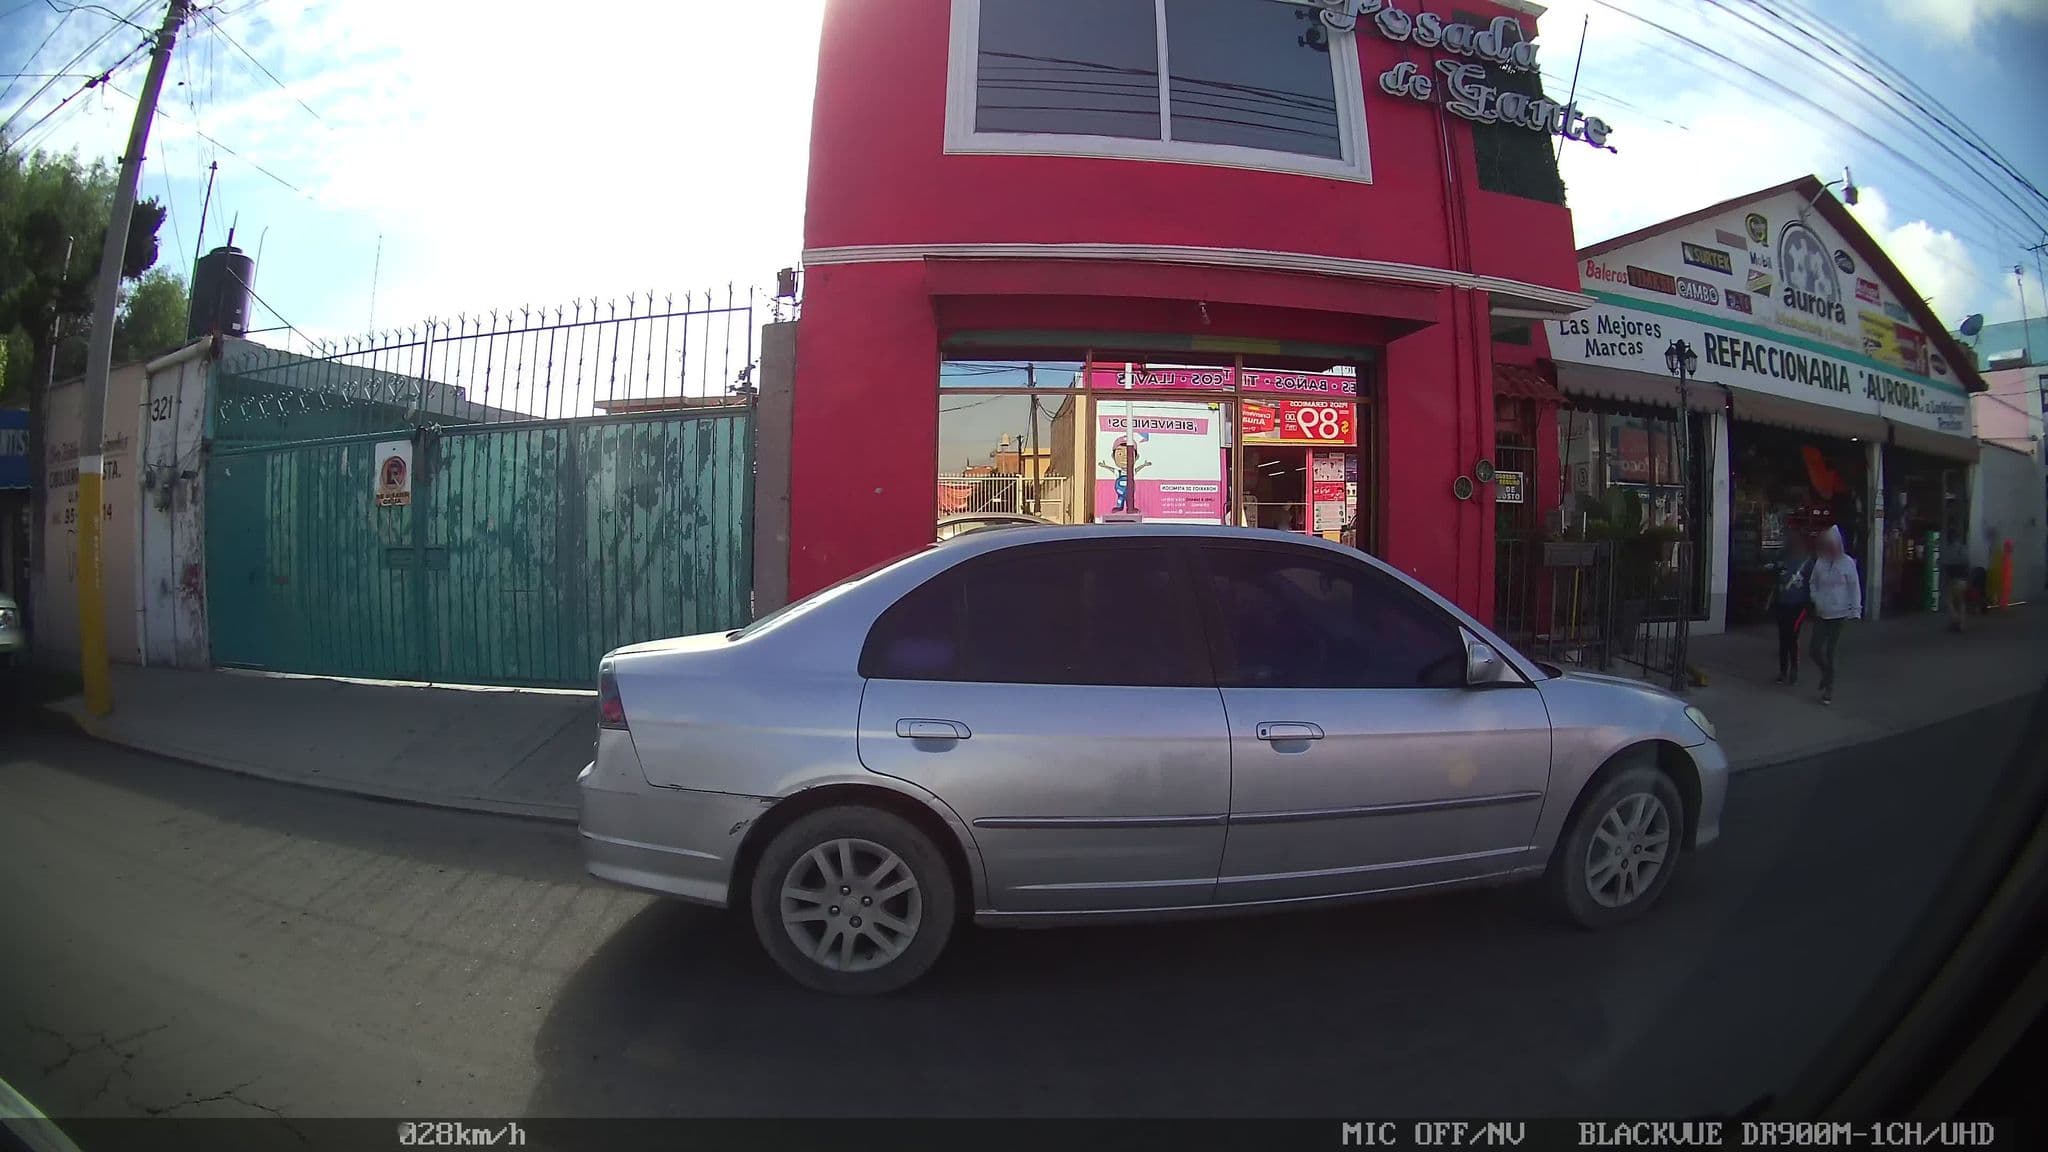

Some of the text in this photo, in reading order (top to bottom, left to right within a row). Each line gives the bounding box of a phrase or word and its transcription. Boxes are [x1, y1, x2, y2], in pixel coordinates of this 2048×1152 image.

[1379, 59, 1618, 149] de Gante
[1586, 259, 1629, 284] Baleros
[1783, 286, 1847, 326] aurora
[1560, 314, 1662, 339] Las Mejores
[1585, 338, 1644, 359] Marcas
[1703, 331, 1852, 394] REFACCIONARIA
[152, 395, 173, 422] 321
